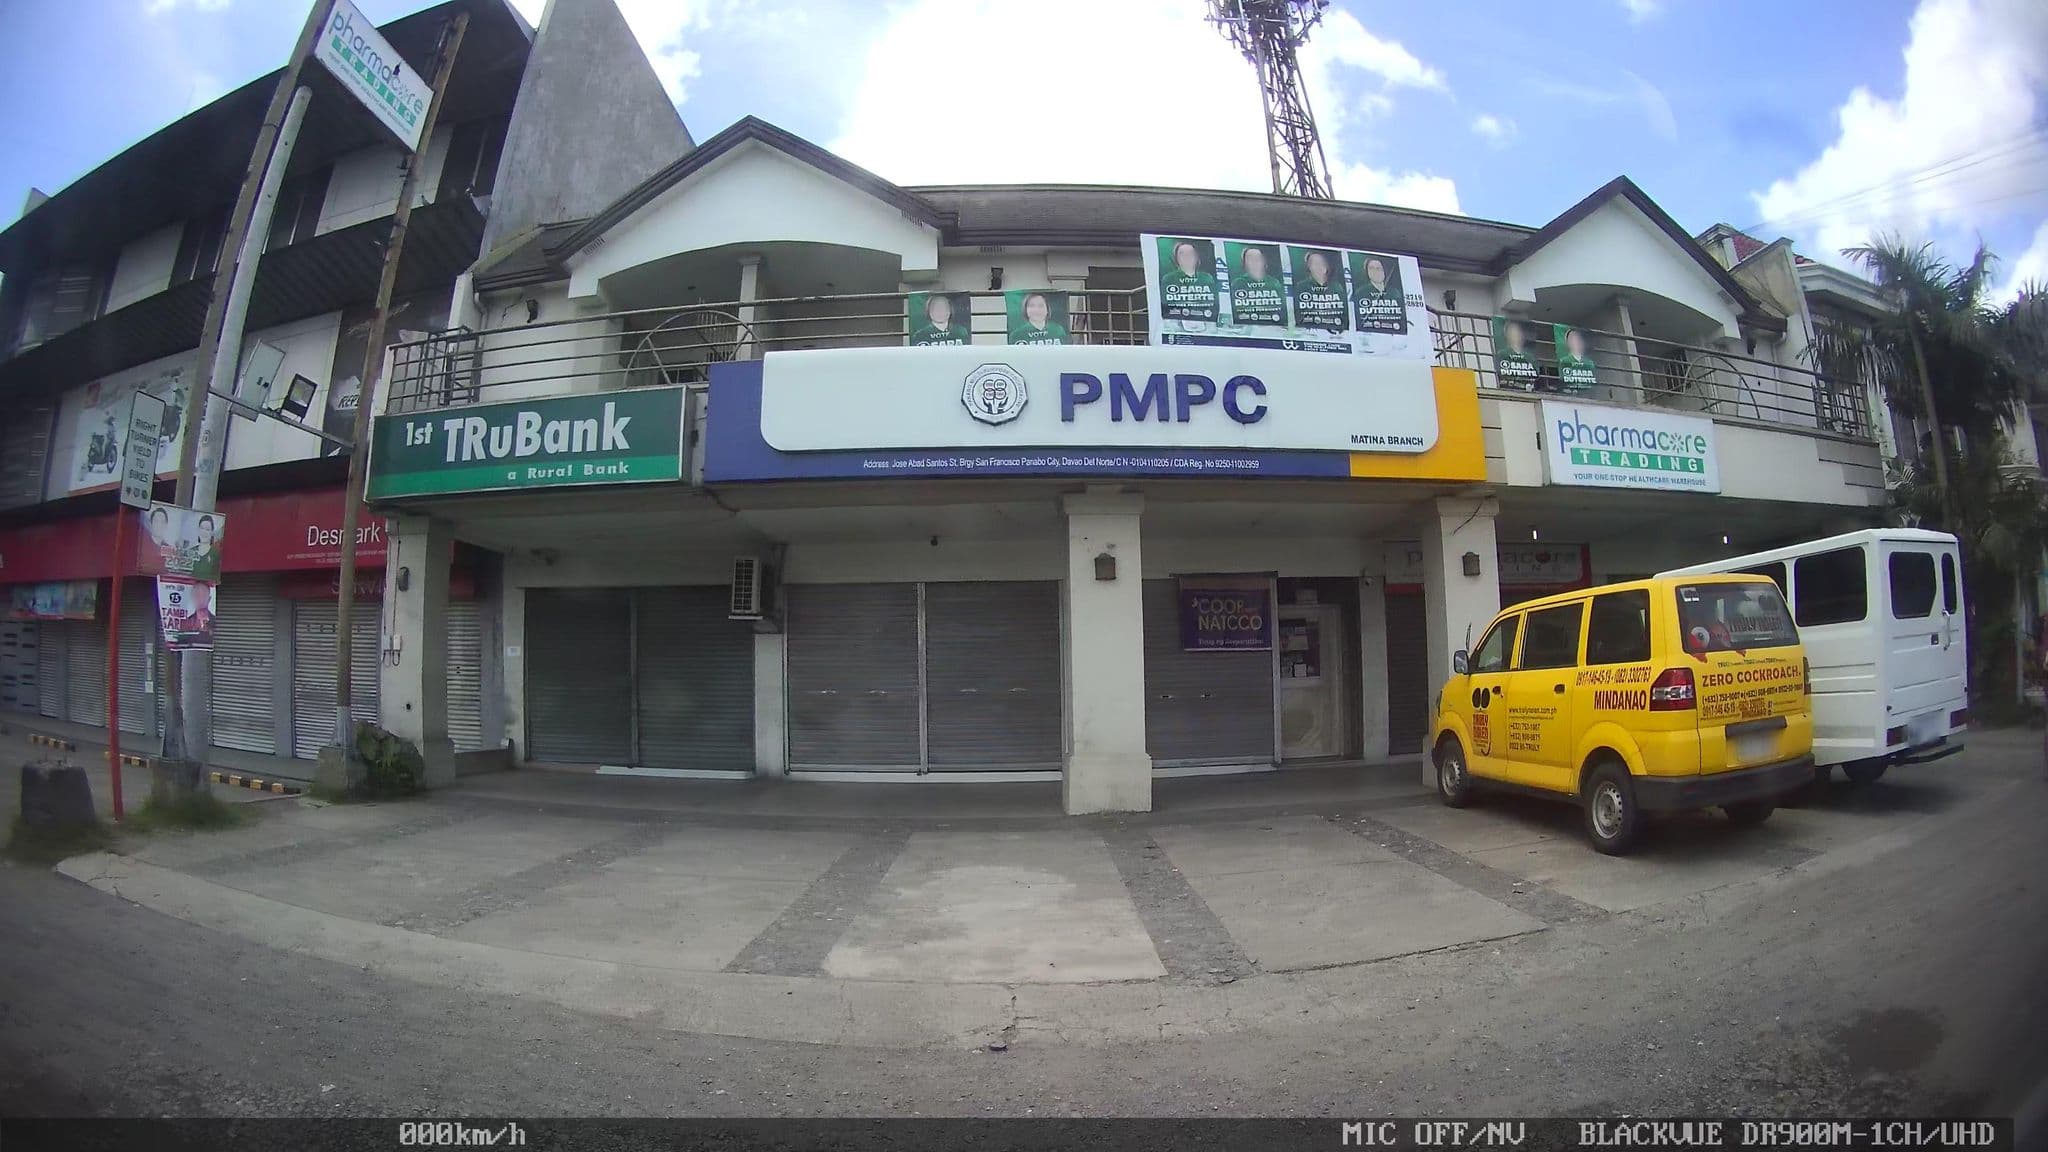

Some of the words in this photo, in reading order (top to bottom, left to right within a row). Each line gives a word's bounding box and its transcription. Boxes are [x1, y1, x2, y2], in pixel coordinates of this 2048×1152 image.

[1180, 285, 1211, 293] SARA
[1248, 290, 1278, 298] SARA
[1166, 293, 1214, 301] DUTERTE
[1235, 298, 1282, 306] DUTERTE
[1312, 294, 1340, 302] SARA
[1372, 299, 1398, 307] SARA
[1360, 307, 1401, 315] DUTERTE
[1511, 361, 1534, 370] SARA
[1573, 369, 1593, 377] SARA
[1564, 376, 1597, 384] DUTERTE
[1060, 372, 1267, 425] PMPC
[136, 418, 157, 432] RIGHT
[406, 421, 433, 446] 1st
[443, 401, 633, 462] TRuBank
[1557, 409, 1707, 454] pharmacore
[130, 429, 157, 446] TURNER
[1351, 434, 1385, 445] MATINA
[1387, 435, 1424, 446] BRANCH
[133, 444, 152, 458] YIELD
[136, 459, 145, 468] TO
[892, 459, 908, 468] Jose
[908, 459, 925, 468] Abad
[926, 458, 949, 467] Santos
[976, 458, 989, 467] San
[1021, 457, 1046, 466] Panabo
[1062, 457, 1083, 466] Davao
[1084, 457, 1096, 466] Del
[1579, 448, 1698, 472] TRADING
[507, 470, 517, 480] a
[528, 464, 573, 480] Rural
[583, 461, 630, 476] Bank
[1594, 473, 1609, 481] ONE
[1611, 474, 1627, 482] STOP
[307, 521, 380, 546] Desark
[1199, 615, 1264, 631] NATCCO
[1702, 672, 1733, 687] ZERO
[1737, 665, 1802, 683] COCKROACH.
[1593, 689, 1647, 710] MINDANAO
